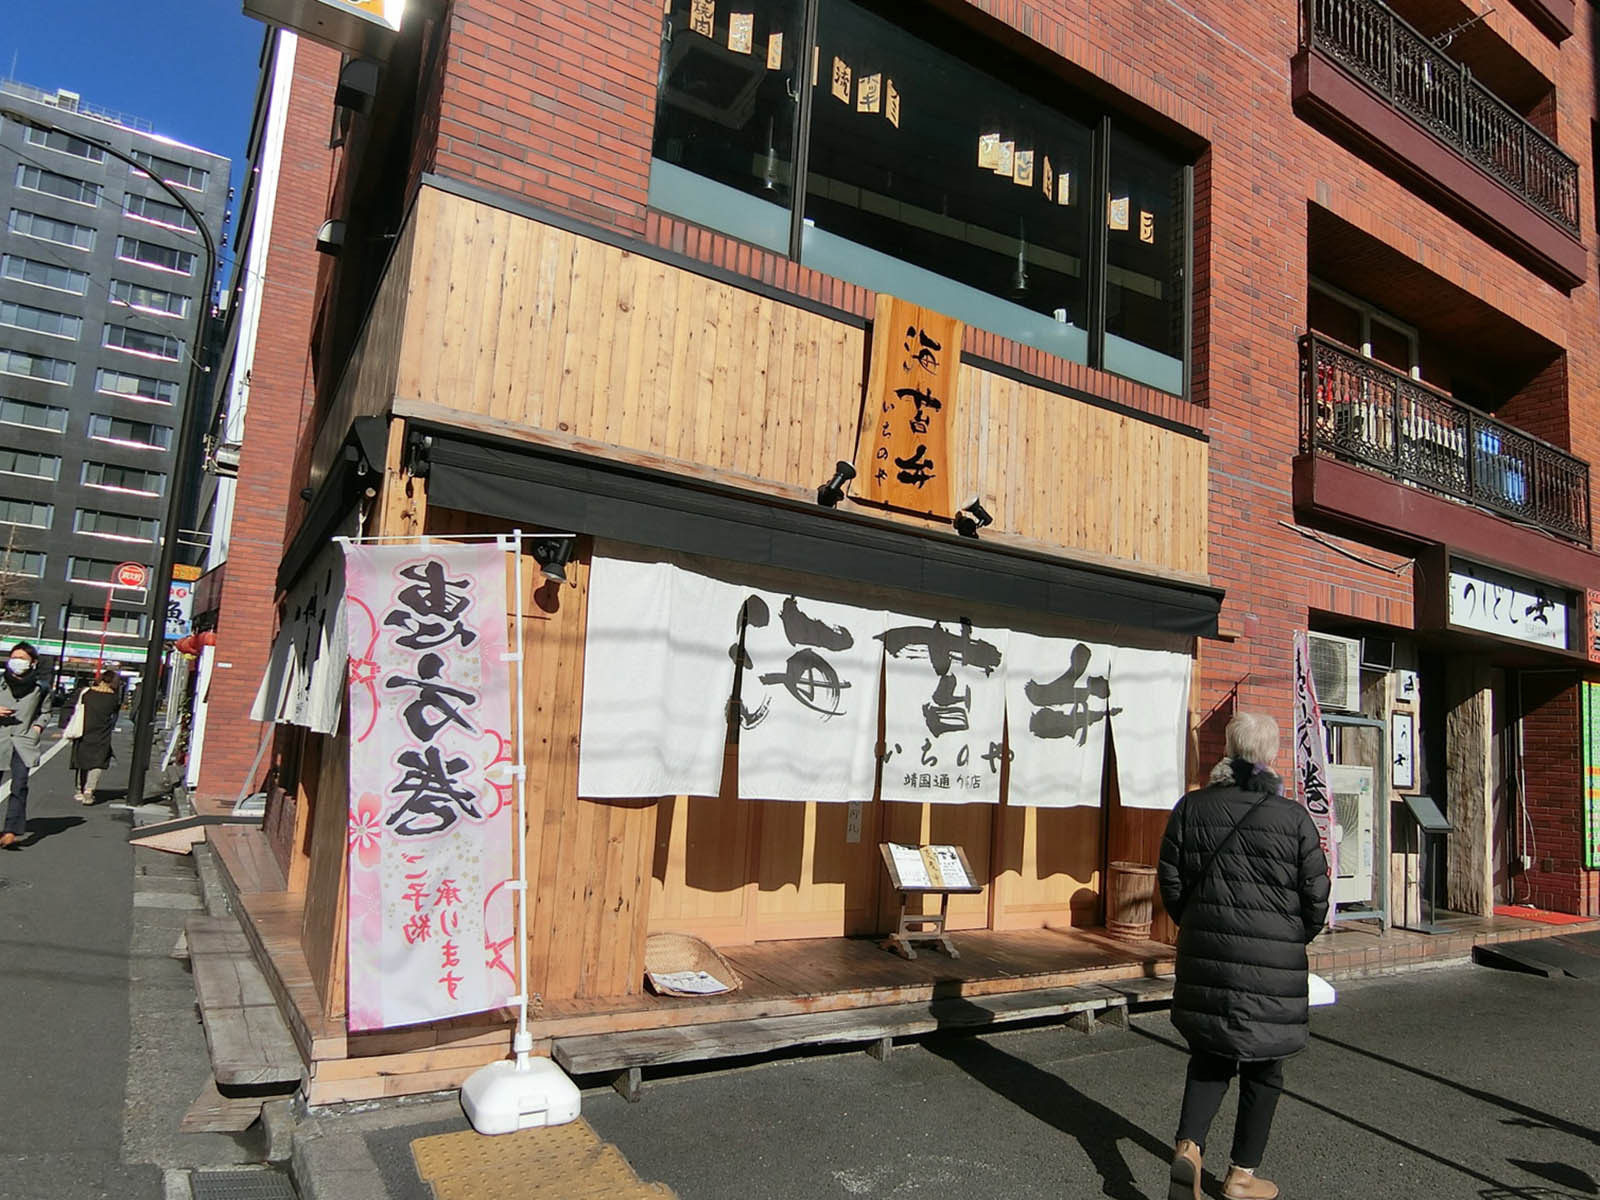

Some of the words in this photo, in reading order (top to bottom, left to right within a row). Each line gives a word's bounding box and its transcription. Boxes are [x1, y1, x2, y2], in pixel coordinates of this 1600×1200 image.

[874, 399, 896, 488] いちのや
[895, 326, 943, 490] 海苔弁
[724, 594, 1123, 748] 海苔弁
[875, 738, 1015, 774] いちのや
